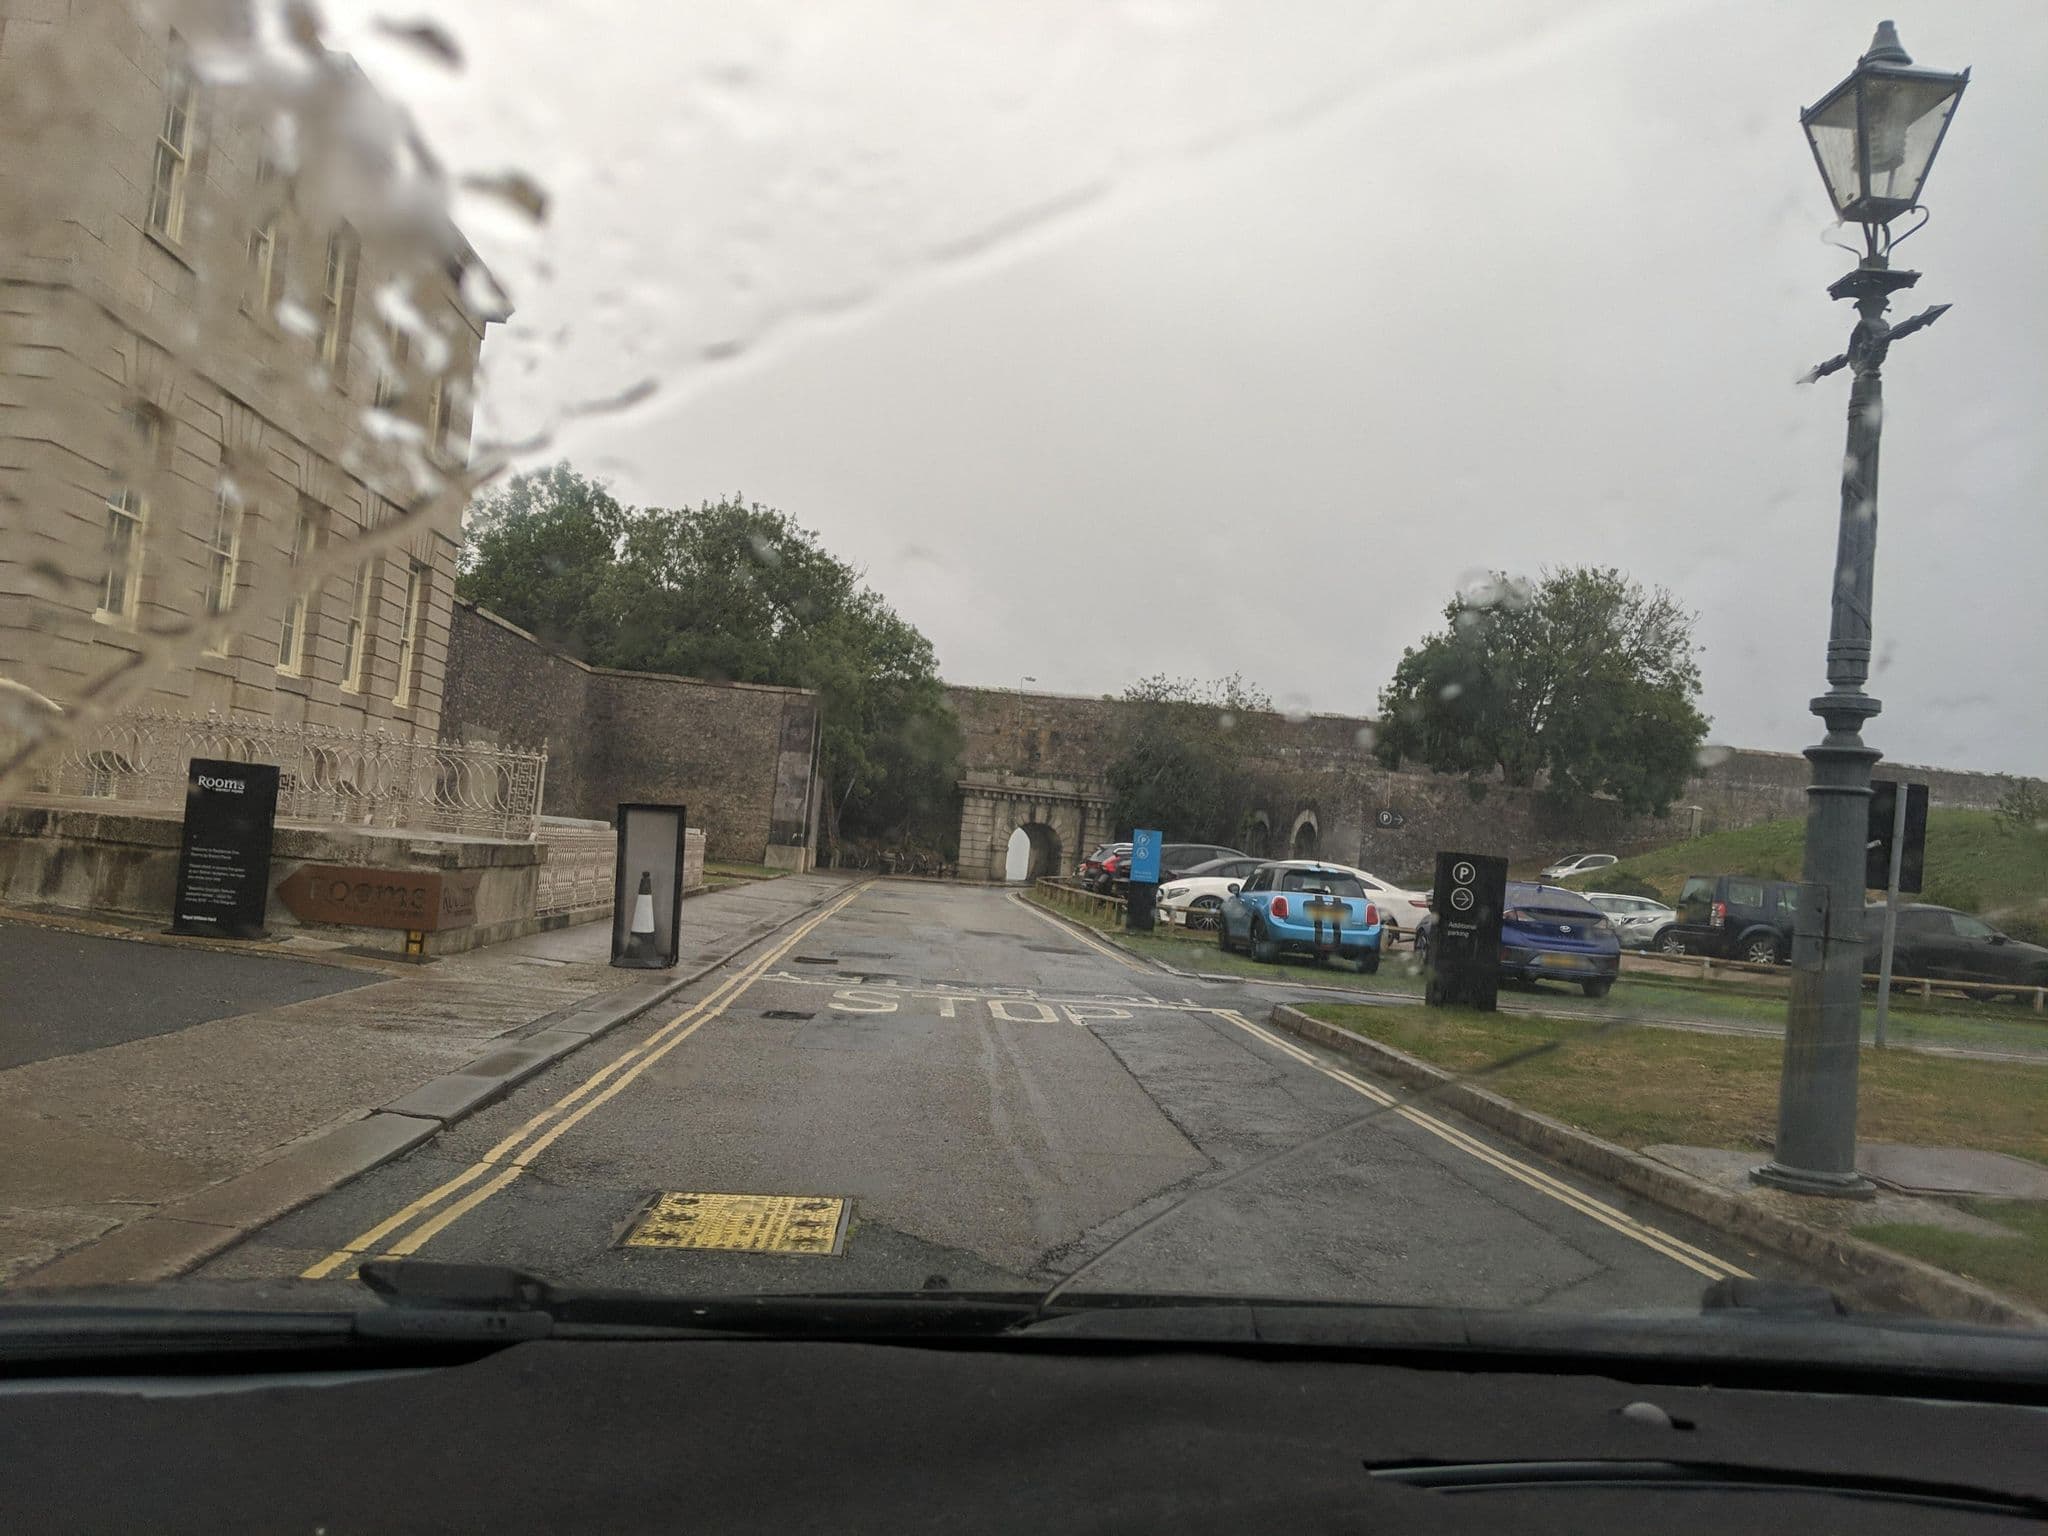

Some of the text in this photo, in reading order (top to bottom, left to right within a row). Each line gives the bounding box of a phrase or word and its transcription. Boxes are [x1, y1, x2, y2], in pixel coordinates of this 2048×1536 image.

[198, 775, 245, 790] Rooms
[1448, 921, 1477, 930] Additional
[1447, 930, 1469, 938] parking
[829, 990, 1133, 1025] STOP
